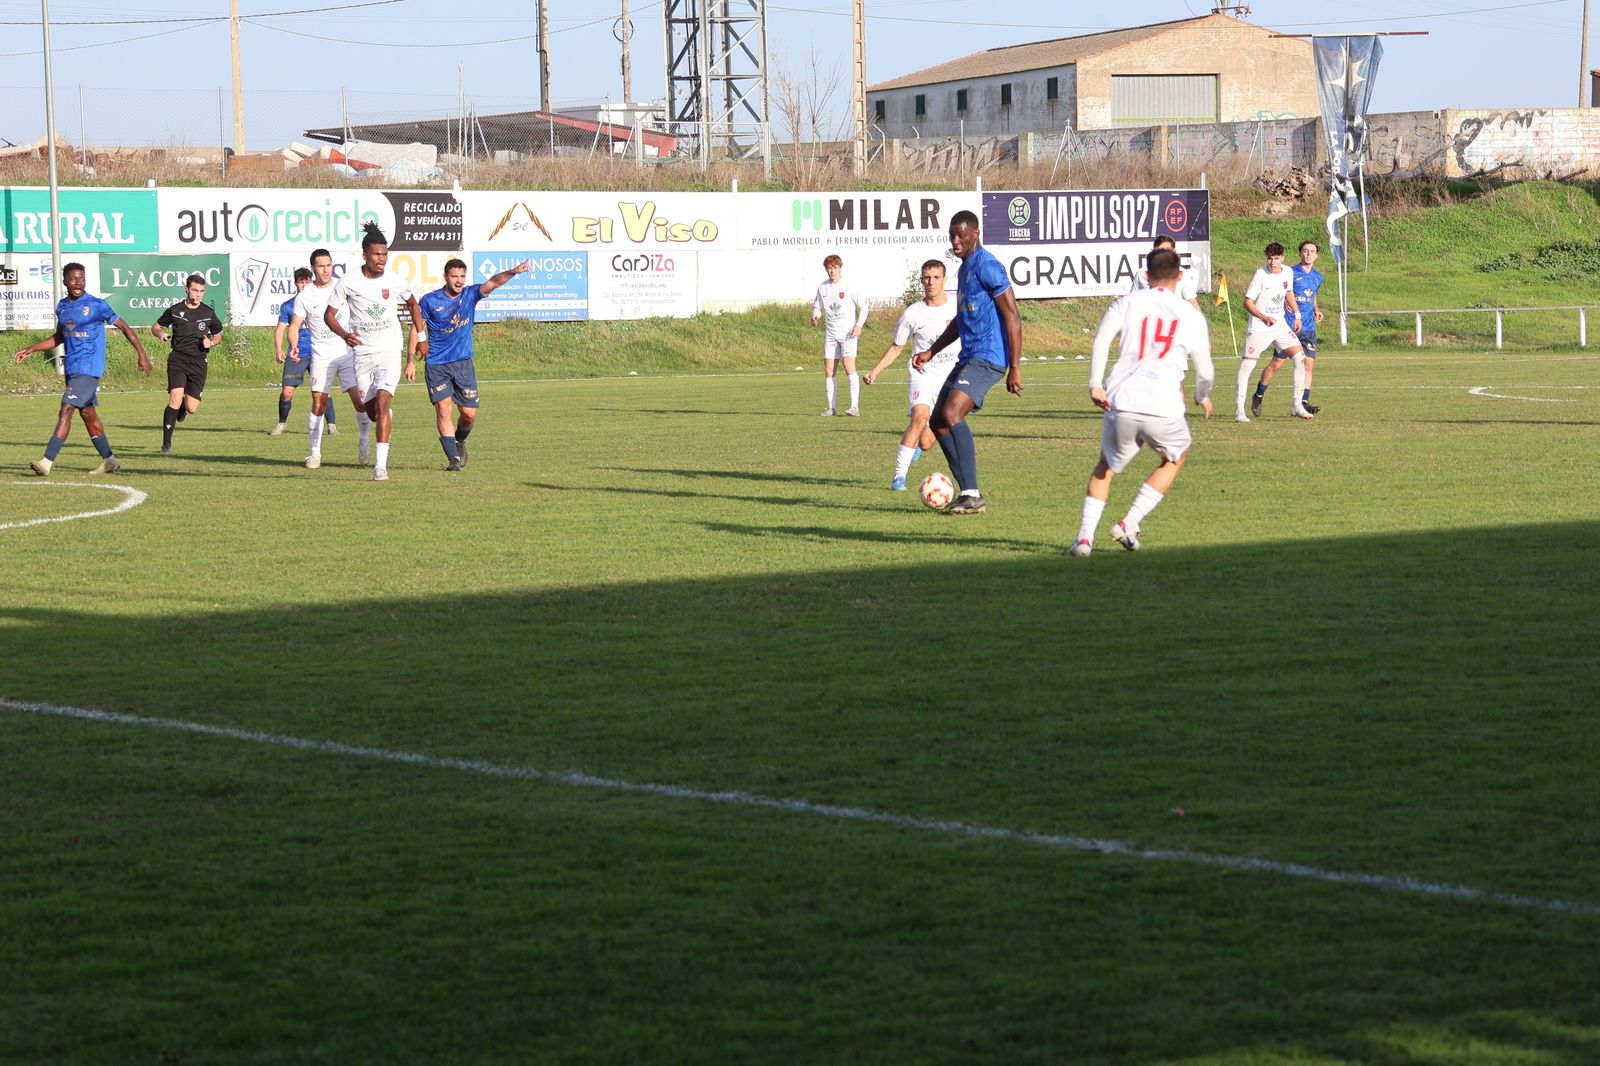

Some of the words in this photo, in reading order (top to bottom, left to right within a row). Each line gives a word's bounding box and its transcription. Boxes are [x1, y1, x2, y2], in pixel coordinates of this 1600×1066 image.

[404, 203, 461, 212] RECICLADO
[829, 199, 940, 230] MILAR
[1038, 195, 1160, 240] IMPULSO27
[404, 217, 416, 225] DE
[417, 215, 462, 225] VEHÍCULOS
[404, 232, 411, 240] T.
[412, 232, 428, 240] 627
[430, 232, 445, 240] 144
[446, 232, 461, 240] 311
[1009, 228, 1031, 238] TERCERA
[752, 238, 779, 246] PABLO
[782, 237, 823, 246] MORILLO,
[835, 236, 869, 246] (FRENTE
[873, 236, 907, 245] COLEGIO
[910, 235, 934, 244] ARIAS
[1136, 316, 1178, 361] 14
